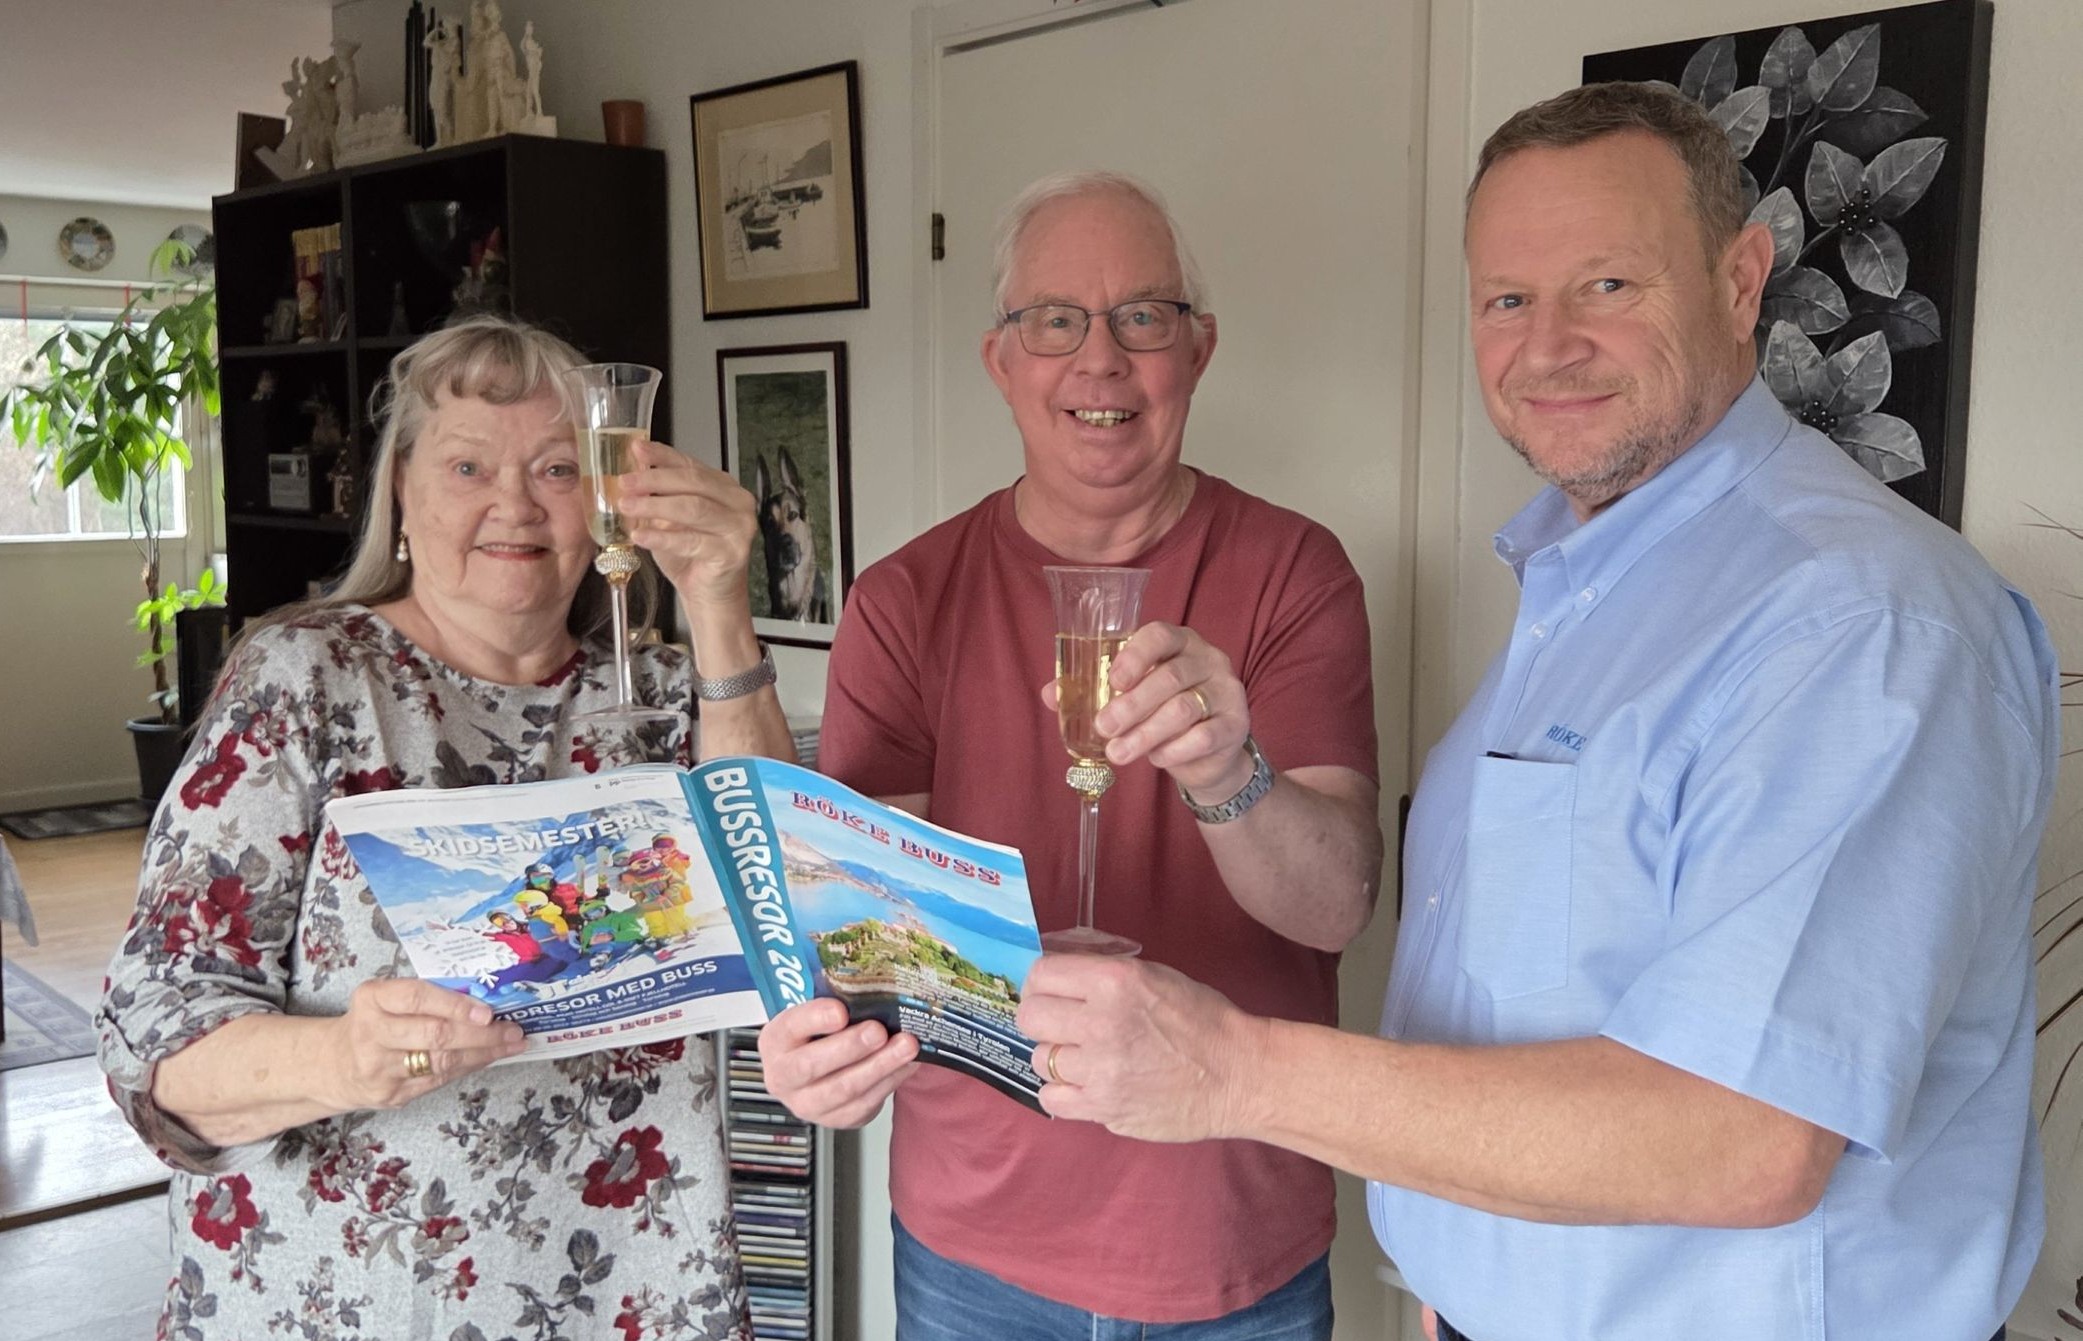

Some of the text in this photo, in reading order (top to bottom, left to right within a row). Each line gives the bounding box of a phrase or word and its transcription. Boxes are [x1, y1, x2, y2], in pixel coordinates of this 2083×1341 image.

[405, 812, 652, 857] SKIDSEMESTER!
[791, 791, 1001, 887] RÖKE BUSS
[704, 766, 808, 1009] BUSSRESOR 202
[606, 977, 656, 1000] MED
[661, 960, 718, 985] BUSS
[620, 1009, 684, 1031] BUSS
